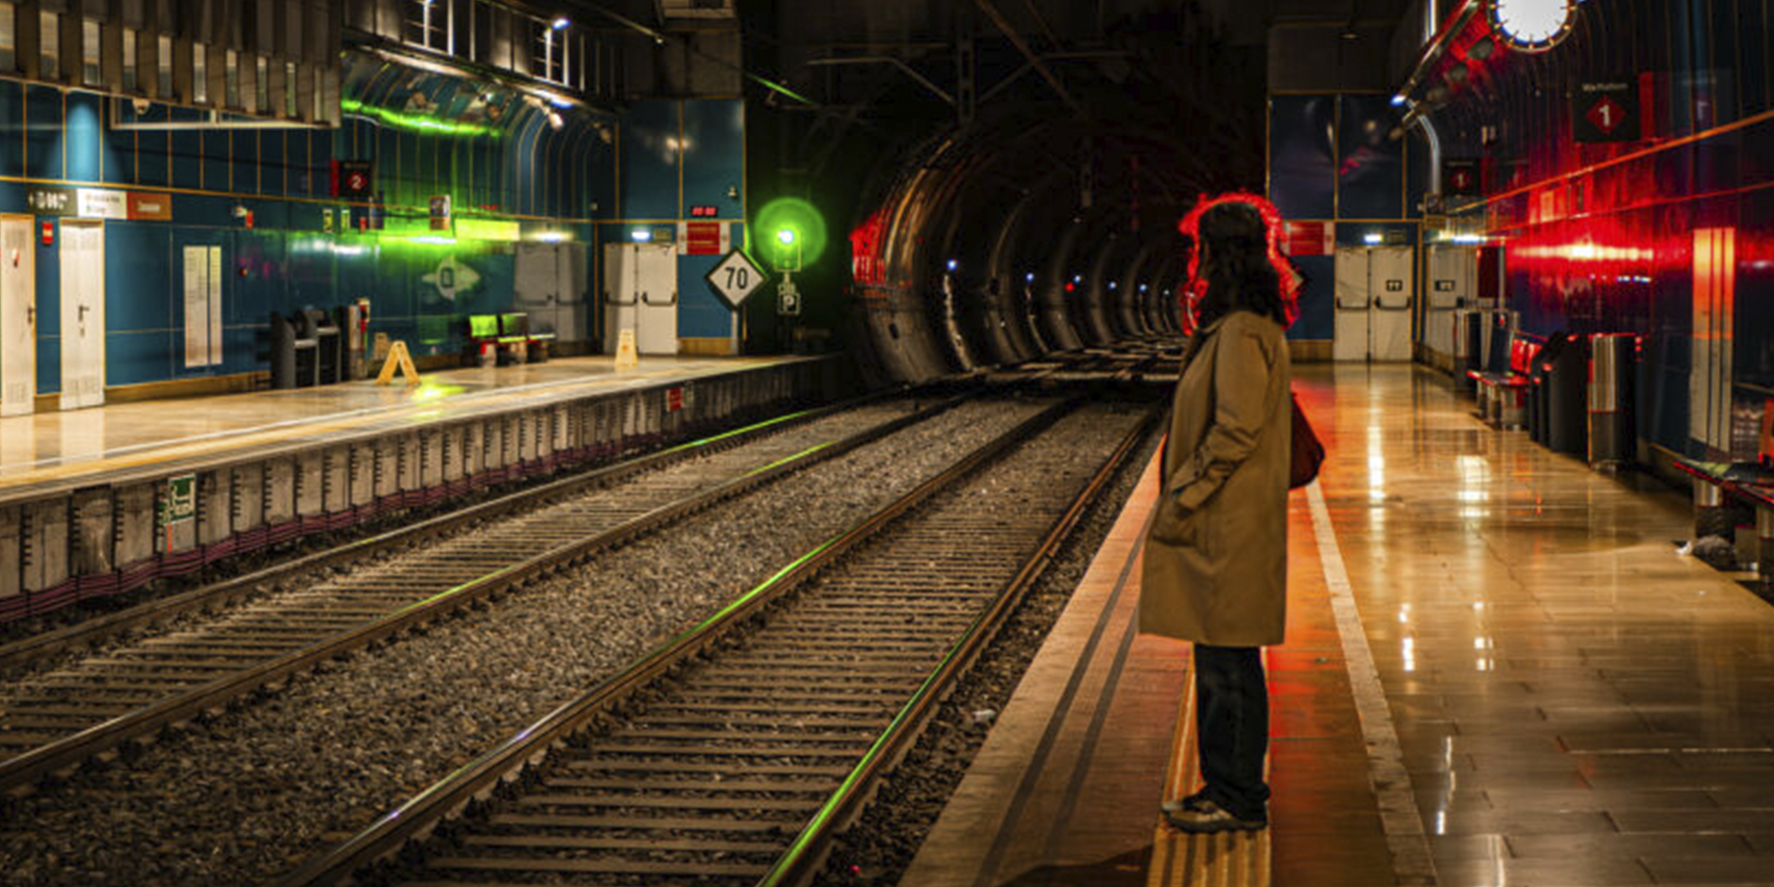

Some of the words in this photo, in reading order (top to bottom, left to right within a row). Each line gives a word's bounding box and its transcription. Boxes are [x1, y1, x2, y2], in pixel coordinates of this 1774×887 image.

[1599, 104, 1610, 127] 1
[351, 175, 361, 190] 2
[725, 266, 748, 290] 70
[783, 294, 795, 312] P
